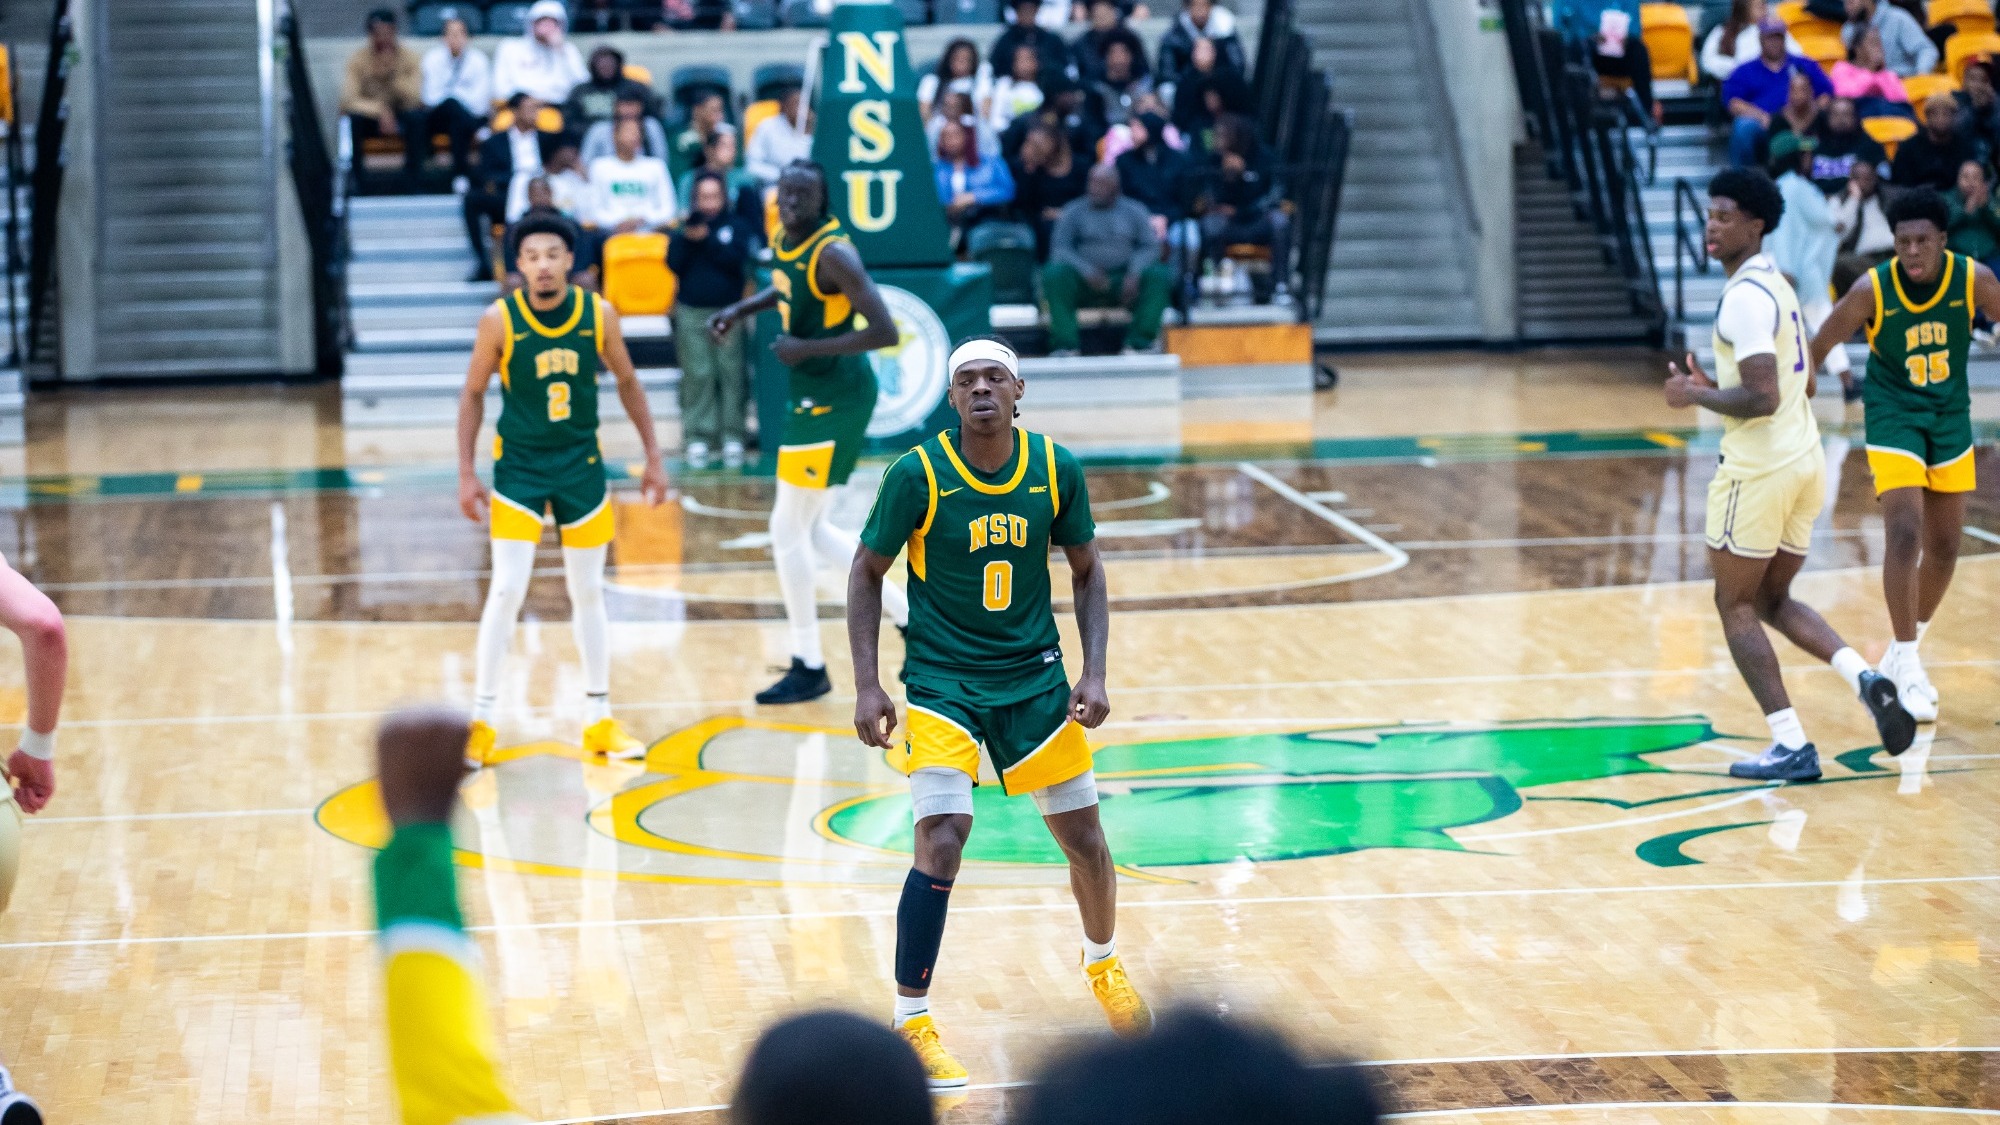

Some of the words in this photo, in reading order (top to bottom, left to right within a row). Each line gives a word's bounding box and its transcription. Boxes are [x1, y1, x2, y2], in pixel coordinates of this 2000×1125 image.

[836, 30, 904, 232] NSU
[1905, 321, 1948, 353] NSU
[535, 348, 579, 379] NSU
[1905, 350, 1949, 387] 35
[546, 381, 571, 422] 2
[969, 513, 1028, 553] NSU
[983, 560, 1013, 611] 0
